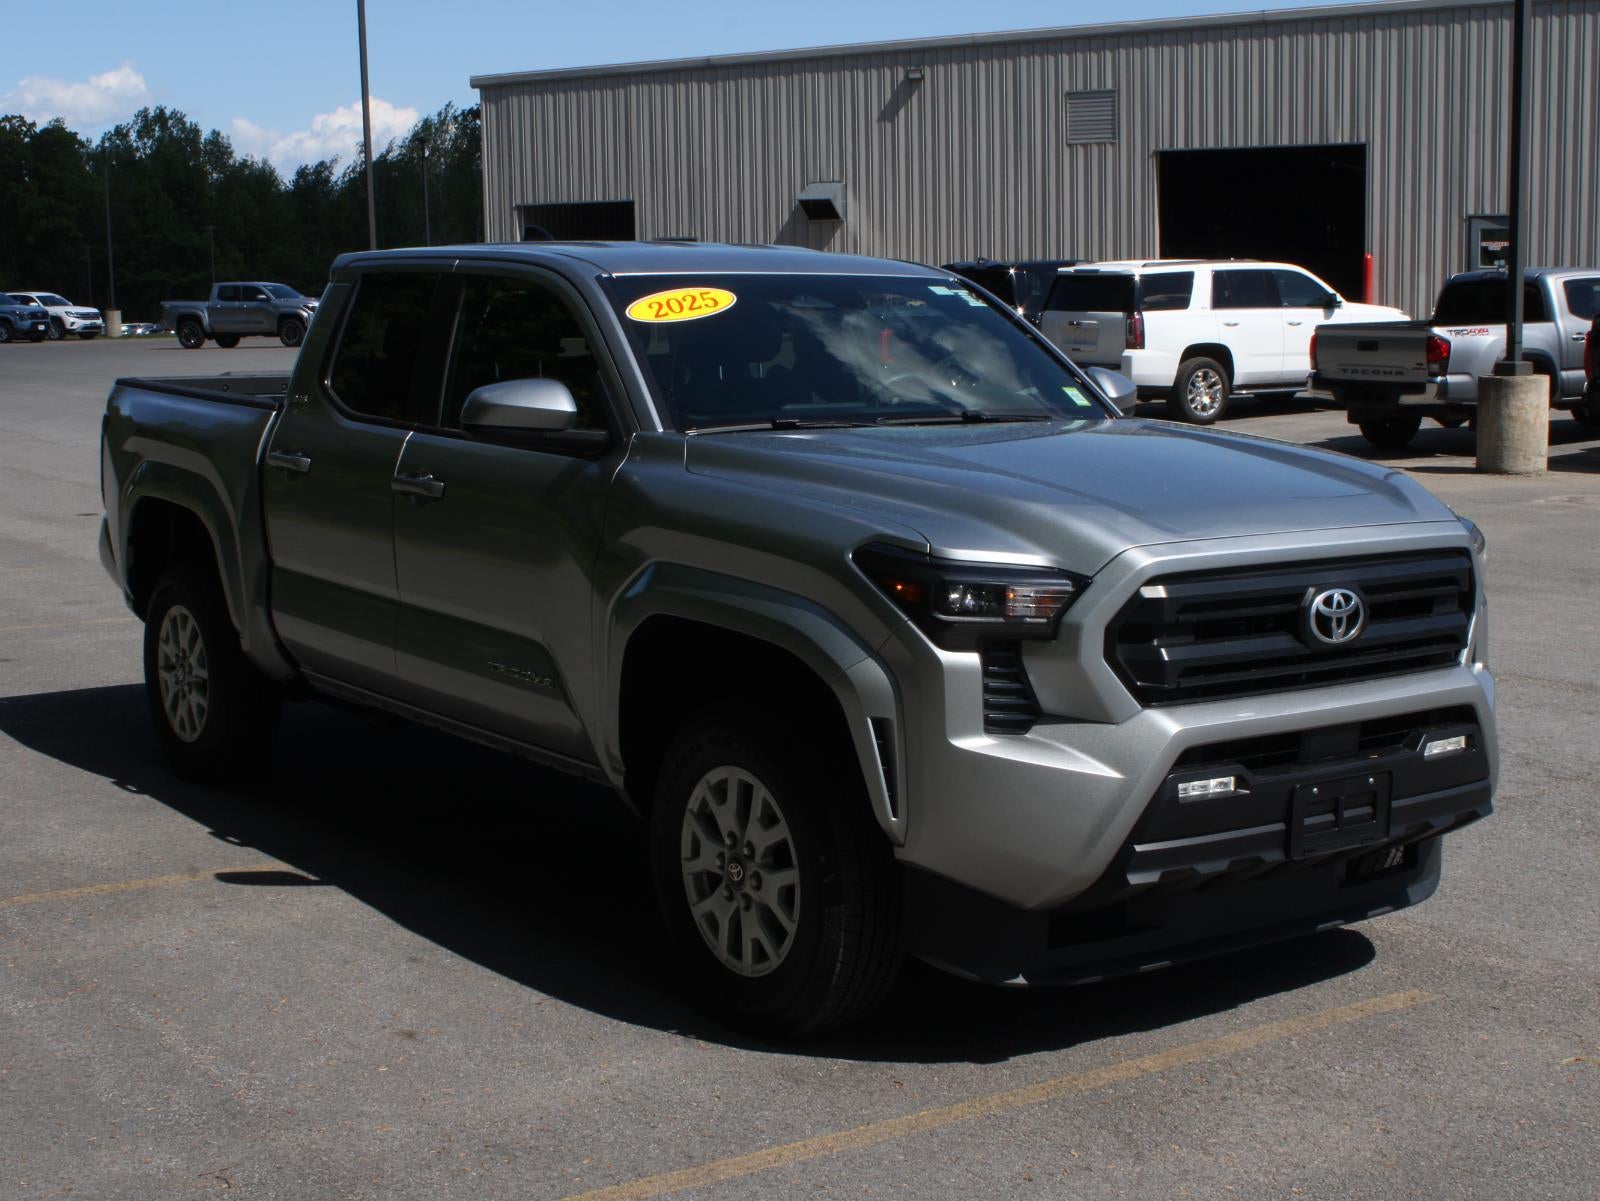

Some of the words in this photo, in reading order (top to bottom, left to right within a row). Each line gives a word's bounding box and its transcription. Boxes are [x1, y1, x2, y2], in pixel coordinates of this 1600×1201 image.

[648, 291, 719, 319] 2025
[1343, 368, 1404, 376] TACOMA
[487, 661, 552, 689] TACOMA
